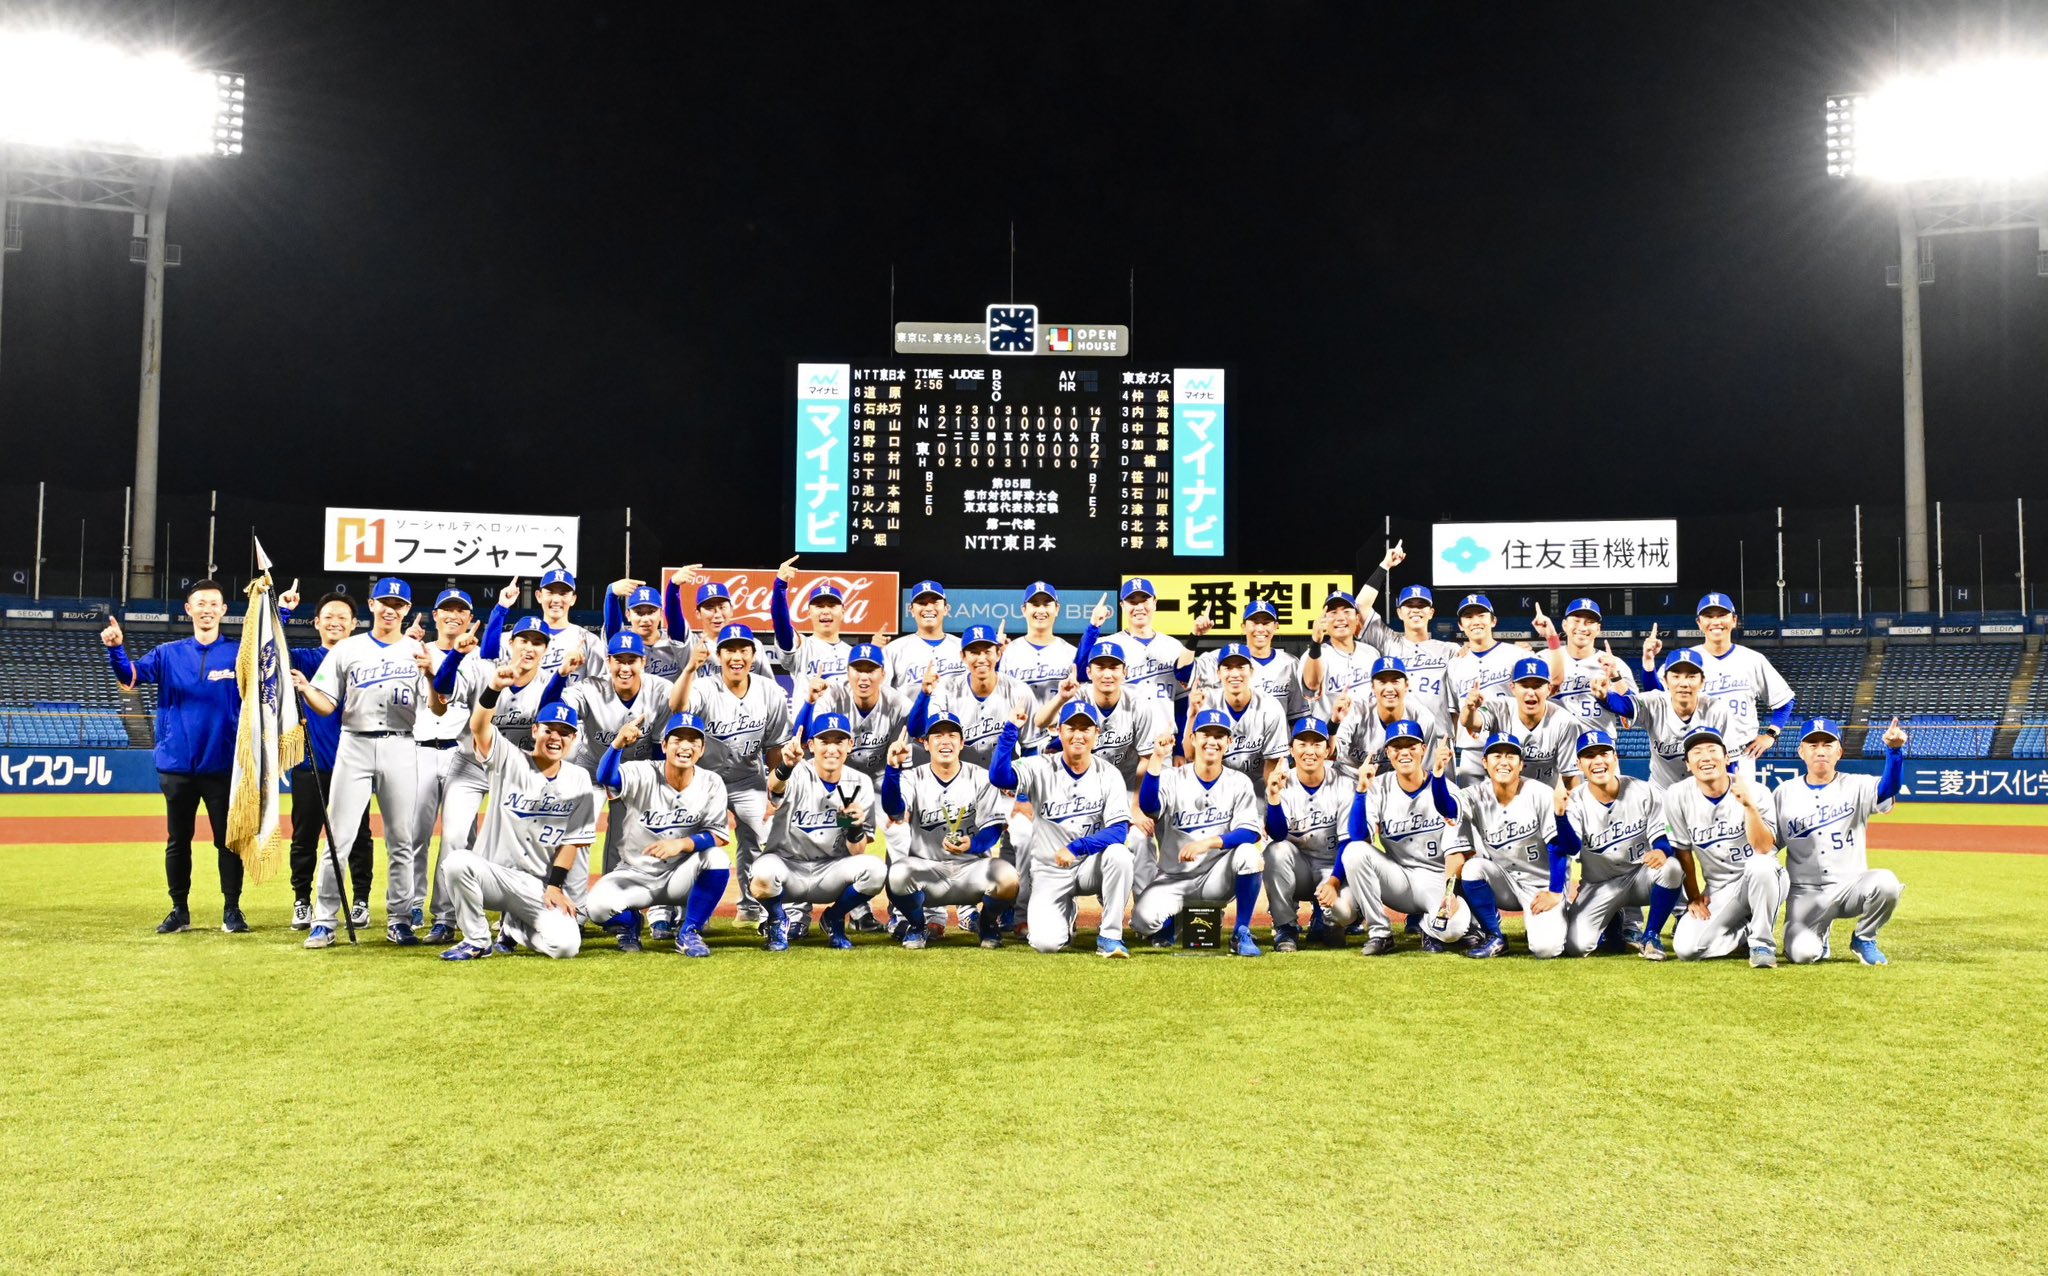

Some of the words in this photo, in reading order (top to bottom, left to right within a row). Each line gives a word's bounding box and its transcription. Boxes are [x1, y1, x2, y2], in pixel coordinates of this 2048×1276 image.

[897, 331, 988, 346] 東京に、家を持とう。
[1078, 329, 1117, 340] OPEN
[1078, 342, 1116, 350] HOUSE
[915, 369, 943, 378] TIME
[949, 369, 984, 379] JUDGE
[992, 369, 1002, 380] B
[1060, 371, 1075, 380] AV
[1123, 372, 1171, 384] 東京ガス
[915, 379, 942, 389] 2:56
[992, 381, 1002, 391] S
[1059, 382, 1075, 391] HR
[854, 387, 860, 397] 8
[864, 386, 901, 399] 道原
[1122, 391, 1128, 400] 4
[854, 403, 860, 413] 6
[864, 403, 901, 415] 石井巧
[1122, 407, 1128, 417] 3
[1132, 406, 1169, 418] 内海
[854, 420, 860, 430] 9
[864, 419, 901, 431] 向山
[918, 417, 928, 428] N
[938, 416, 946, 429] 2
[956, 416, 960, 429] 1
[971, 416, 978, 429] 3
[988, 417, 995, 429] 0
[1005, 417, 1010, 429] 1
[1021, 417, 1028, 430] 0
[1037, 417, 1045, 430] 0
[1054, 417, 1061, 430] 0
[1070, 418, 1078, 430] 0
[1091, 417, 1100, 431] 7
[1122, 423, 1128, 433] 8
[1132, 422, 1169, 435] 中尾
[854, 436, 860, 446] 2
[863, 435, 899, 447] 野口
[1122, 439, 1128, 449] 9
[1131, 439, 1168, 451] 加藤
[916, 442, 929, 456] 東
[938, 442, 945, 455] 0
[955, 443, 960, 455] 1
[971, 443, 978, 455] 0
[987, 443, 995, 456] 0
[1005, 443, 1009, 456] 1
[1021, 443, 1028, 456] 0
[1037, 443, 1045, 456] 0
[1054, 444, 1061, 456] 0
[1070, 444, 1078, 457] 0
[1090, 444, 1099, 458] 2
[853, 452, 859, 462] 5
[864, 451, 900, 464] 中村
[1122, 456, 1128, 465] D
[804, 405, 841, 546] マイナビ
[853, 469, 859, 478] 3
[863, 469, 899, 480] 下川
[1122, 472, 1128, 481] 7
[1182, 410, 1218, 549] マイナビ
[992, 478, 1031, 489] 第95回
[852, 486, 859, 495] D
[863, 484, 900, 497] 池本
[964, 490, 1058, 501] 都市対抗野球大会
[1122, 488, 1128, 498] 5
[1132, 488, 1168, 499] 石川
[853, 501, 858, 511] 7
[862, 501, 900, 513] 火ノ浦
[964, 502, 1058, 514] 東京都代表決定戦
[1122, 505, 1128, 514] 2
[852, 518, 858, 528] 4
[862, 517, 899, 529] 丸山
[986, 518, 1035, 530] 第一代表
[1122, 521, 1128, 530] 6
[1131, 520, 1168, 532] 北本
[852, 535, 858, 544] P
[965, 534, 1056, 551] NTT東日本
[1122, 538, 1128, 547] P
[395, 536, 566, 569] フージャース
[1502, 538, 1670, 570] 住友重機械
[13, 572, 25, 584] Q
[181, 578, 189, 589] P
[389, 582, 401, 594] N
[484, 588, 494, 598] N
[1411, 588, 1422, 597] N
[1663, 595, 1668, 605] J
[1709, 595, 1720, 606] N
[1958, 589, 1968, 600] H
[1522, 598, 1530, 607] K
[1413, 654, 1444, 667] East
[350, 668, 377, 687] NTT
[381, 661, 415, 677] East
[1419, 677, 1440, 695] 24
[1718, 675, 1750, 690] East
[393, 687, 409, 705] 16
[1157, 683, 1174, 699] 20
[555, 707, 569, 720] N
[1729, 700, 1747, 717] 99
[1814, 720, 1824, 731] N
[743, 740, 760, 756] 13
[1535, 768, 1552, 780] 14
[504, 793, 536, 810] NTT
[538, 796, 573, 812] East
[1041, 802, 1069, 816] NTT
[1172, 812, 1202, 827] NTT
[1380, 819, 1407, 835] NTT
[1411, 814, 1445, 831] East
[1788, 815, 1817, 837] NTT
[1819, 802, 1854, 824] East
[539, 826, 564, 845] 27
[1507, 821, 1540, 838] East
[1327, 835, 1337, 849] 3
[1831, 829, 1854, 850] 54
[1427, 841, 1437, 857] 9
[1527, 845, 1539, 862] 5
[1628, 843, 1645, 862] 12
[1730, 844, 1754, 862] 28
